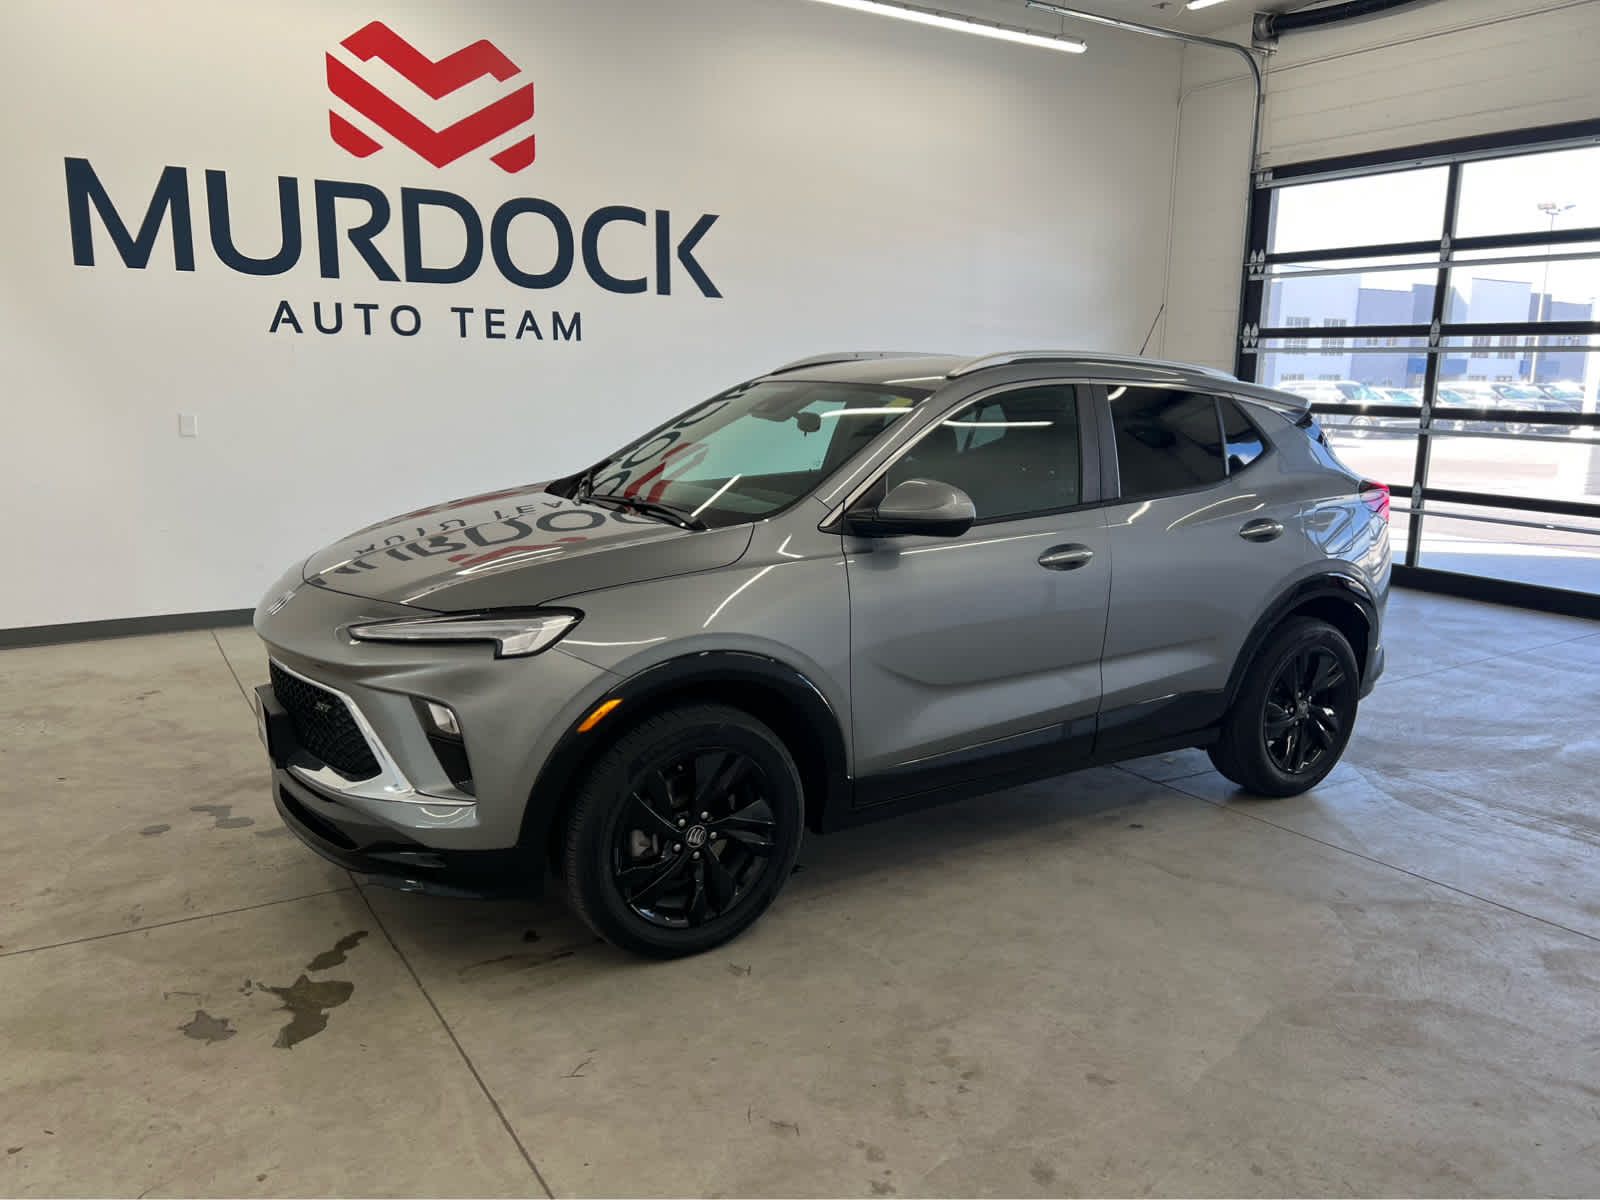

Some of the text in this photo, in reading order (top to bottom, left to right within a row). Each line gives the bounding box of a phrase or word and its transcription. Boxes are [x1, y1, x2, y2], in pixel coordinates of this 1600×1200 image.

[64, 156, 723, 299] MURDOCK
[269, 300, 582, 342] AUTO TEAM
